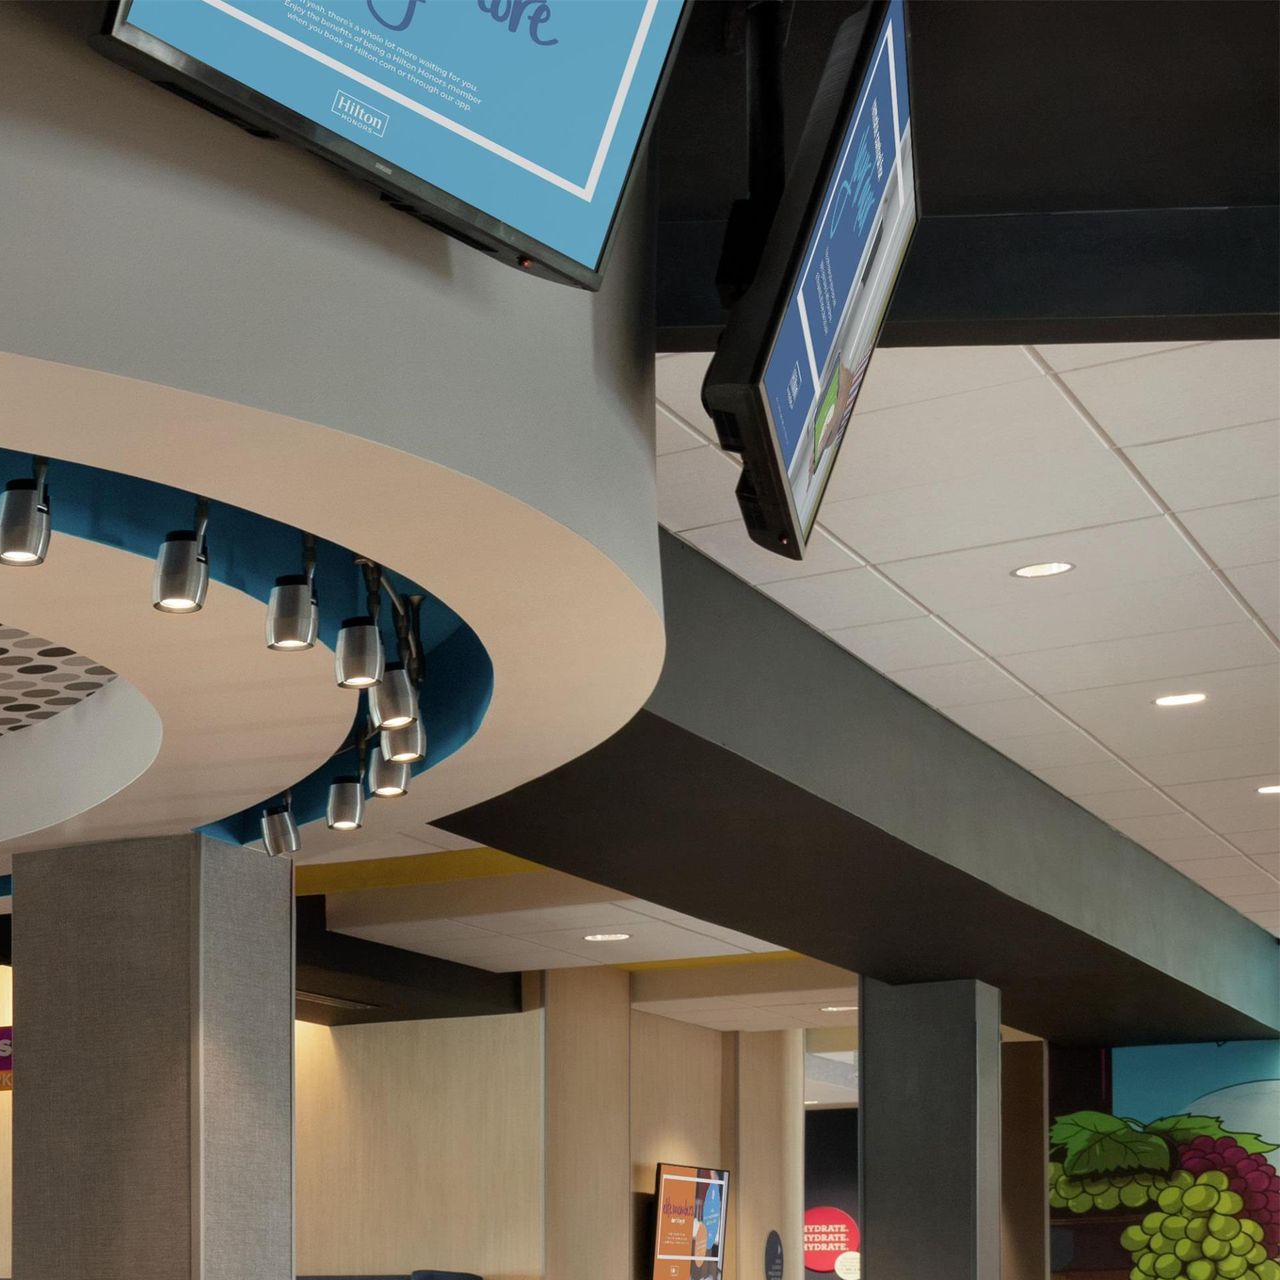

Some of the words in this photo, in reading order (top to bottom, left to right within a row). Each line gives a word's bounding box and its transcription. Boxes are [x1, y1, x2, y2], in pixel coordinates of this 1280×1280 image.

[284, 0, 306, 15] Enjoy
[307, 10, 320, 21] the
[321, 17, 353, 39] benefits
[363, 39, 385, 57] being
[393, 55, 417, 72] Hilton
[418, 67, 447, 87] Honors
[448, 83, 482, 104] member
[287, 12, 308, 27] when
[308, 24, 323, 35] you
[324, 31, 343, 46] book
[344, 42, 353, 50] at
[354, 46, 397, 72] Hilton.com
[397, 69, 406, 77] or
[407, 73, 439, 94] through
[440, 91, 455, 101] our
[328, 11, 354, 28] there's
[361, 28, 384, 43] whole
[385, 40, 396, 50] lot
[396, 46, 418, 61] more
[419, 58, 448, 78] waiting
[449, 72, 461, 82] for
[462, 79, 479, 93] you.
[337, 96, 383, 130] Hilton
[340, 113, 374, 135] HONORS
